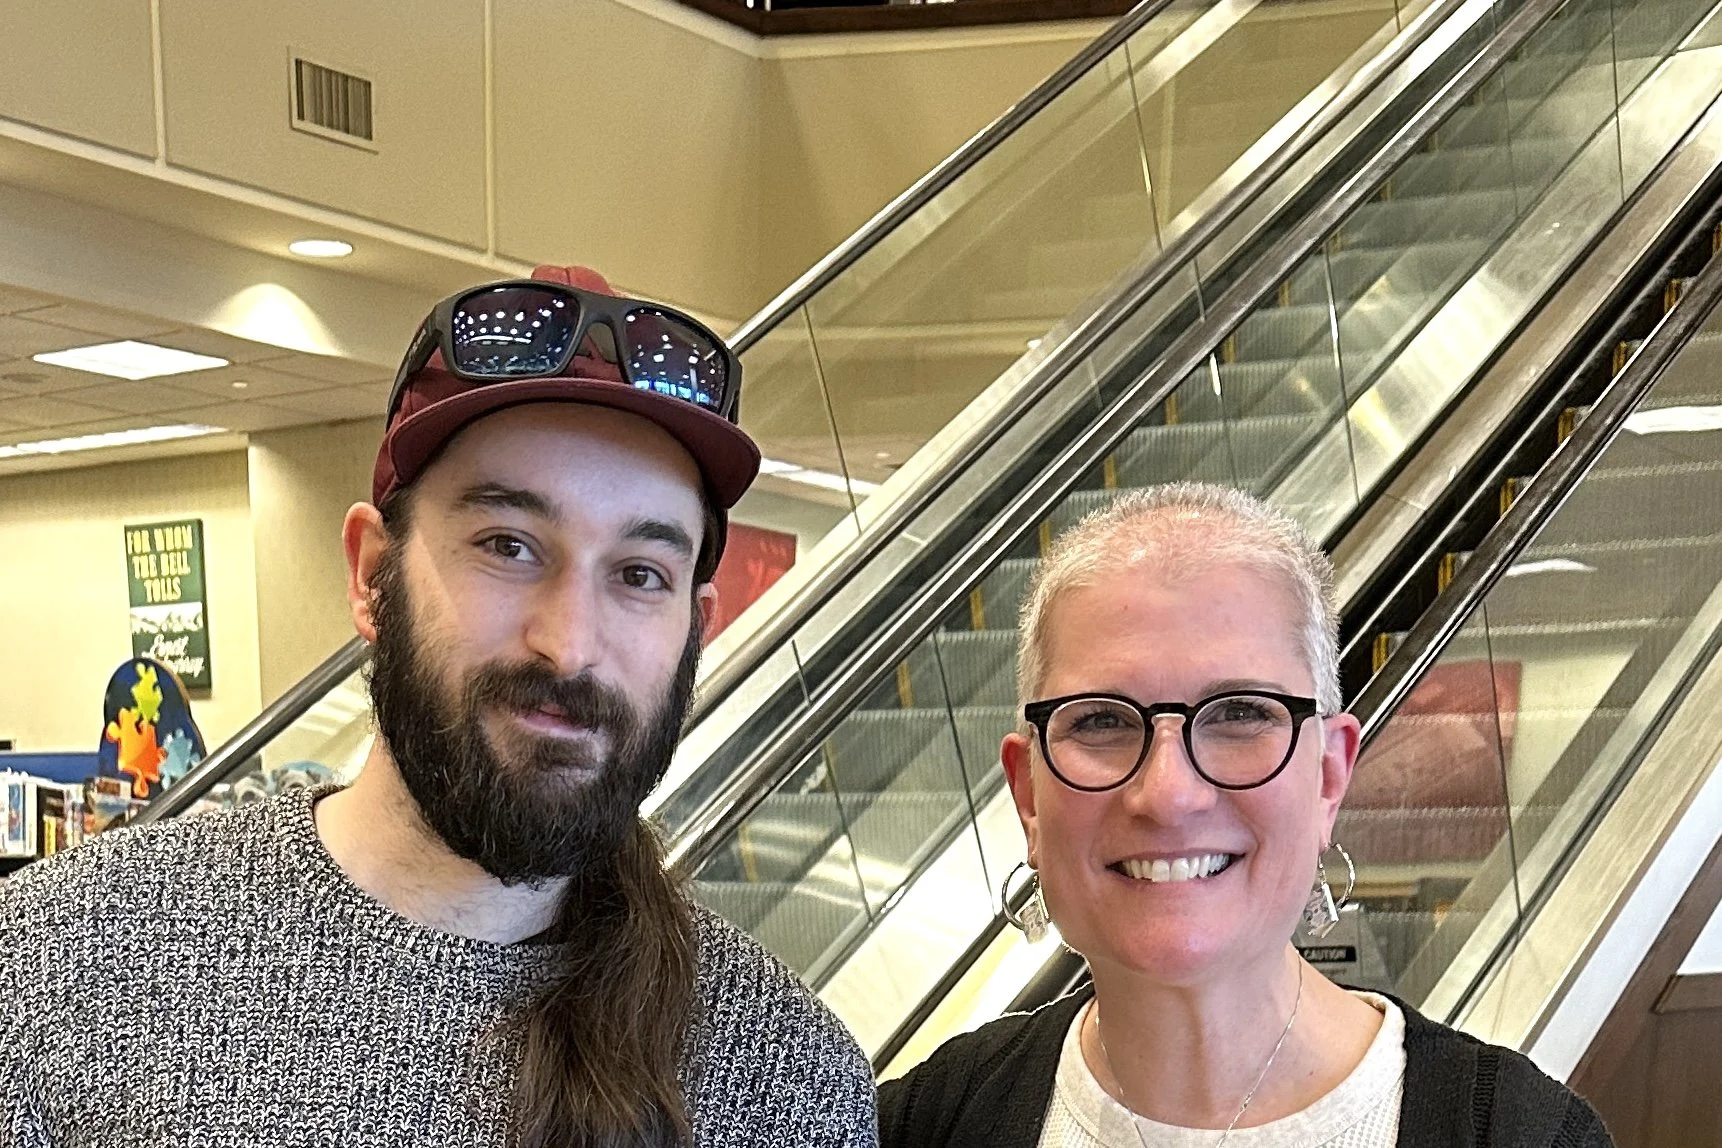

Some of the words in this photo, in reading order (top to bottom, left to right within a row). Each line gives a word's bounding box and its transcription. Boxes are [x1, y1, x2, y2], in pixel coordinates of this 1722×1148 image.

[126, 529, 150, 554] FOR
[154, 525, 193, 551] WHOM
[132, 553, 157, 579] THE
[160, 550, 191, 577] BELL
[144, 576, 182, 603] TOLLS
[1303, 949, 1347, 960] CAUTION
